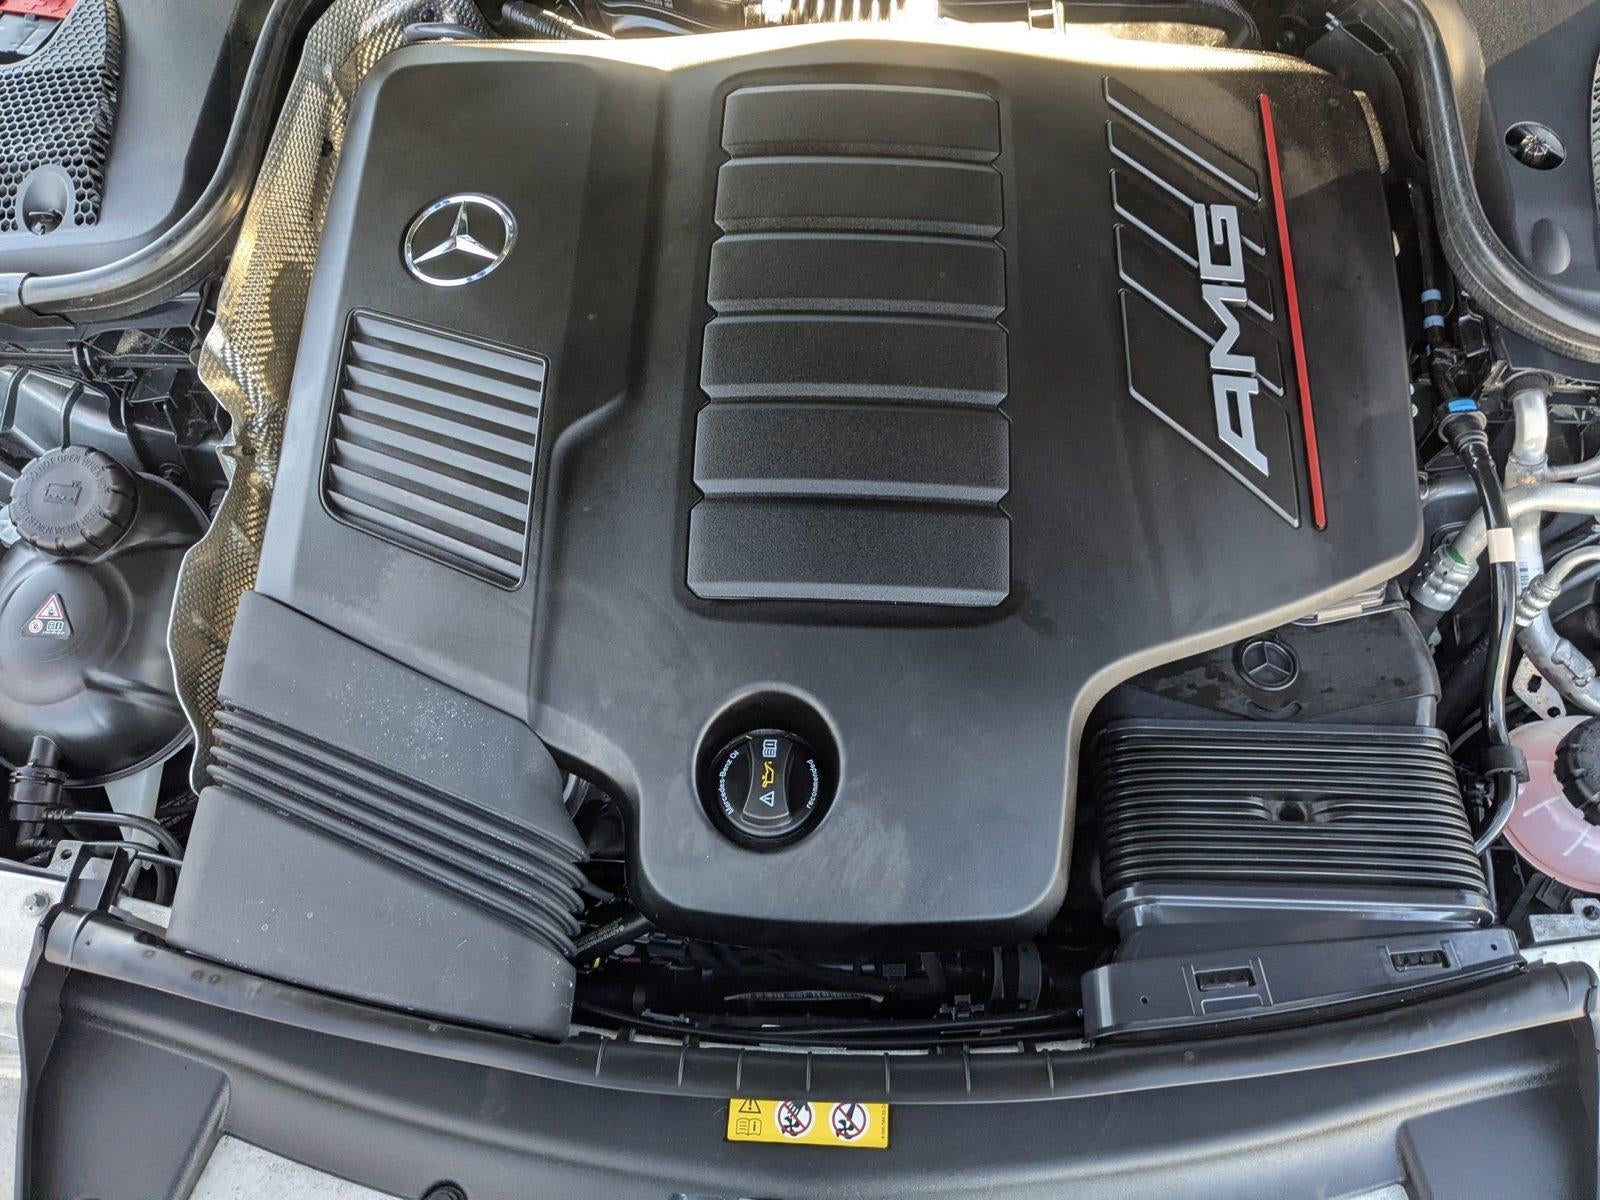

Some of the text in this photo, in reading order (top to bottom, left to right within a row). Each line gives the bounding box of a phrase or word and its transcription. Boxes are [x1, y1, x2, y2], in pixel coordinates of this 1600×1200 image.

[1193, 203, 1269, 478] AMG
[718, 749, 740, 815] Mercedes-Benz Oil
[806, 758, 819, 810] recommended
